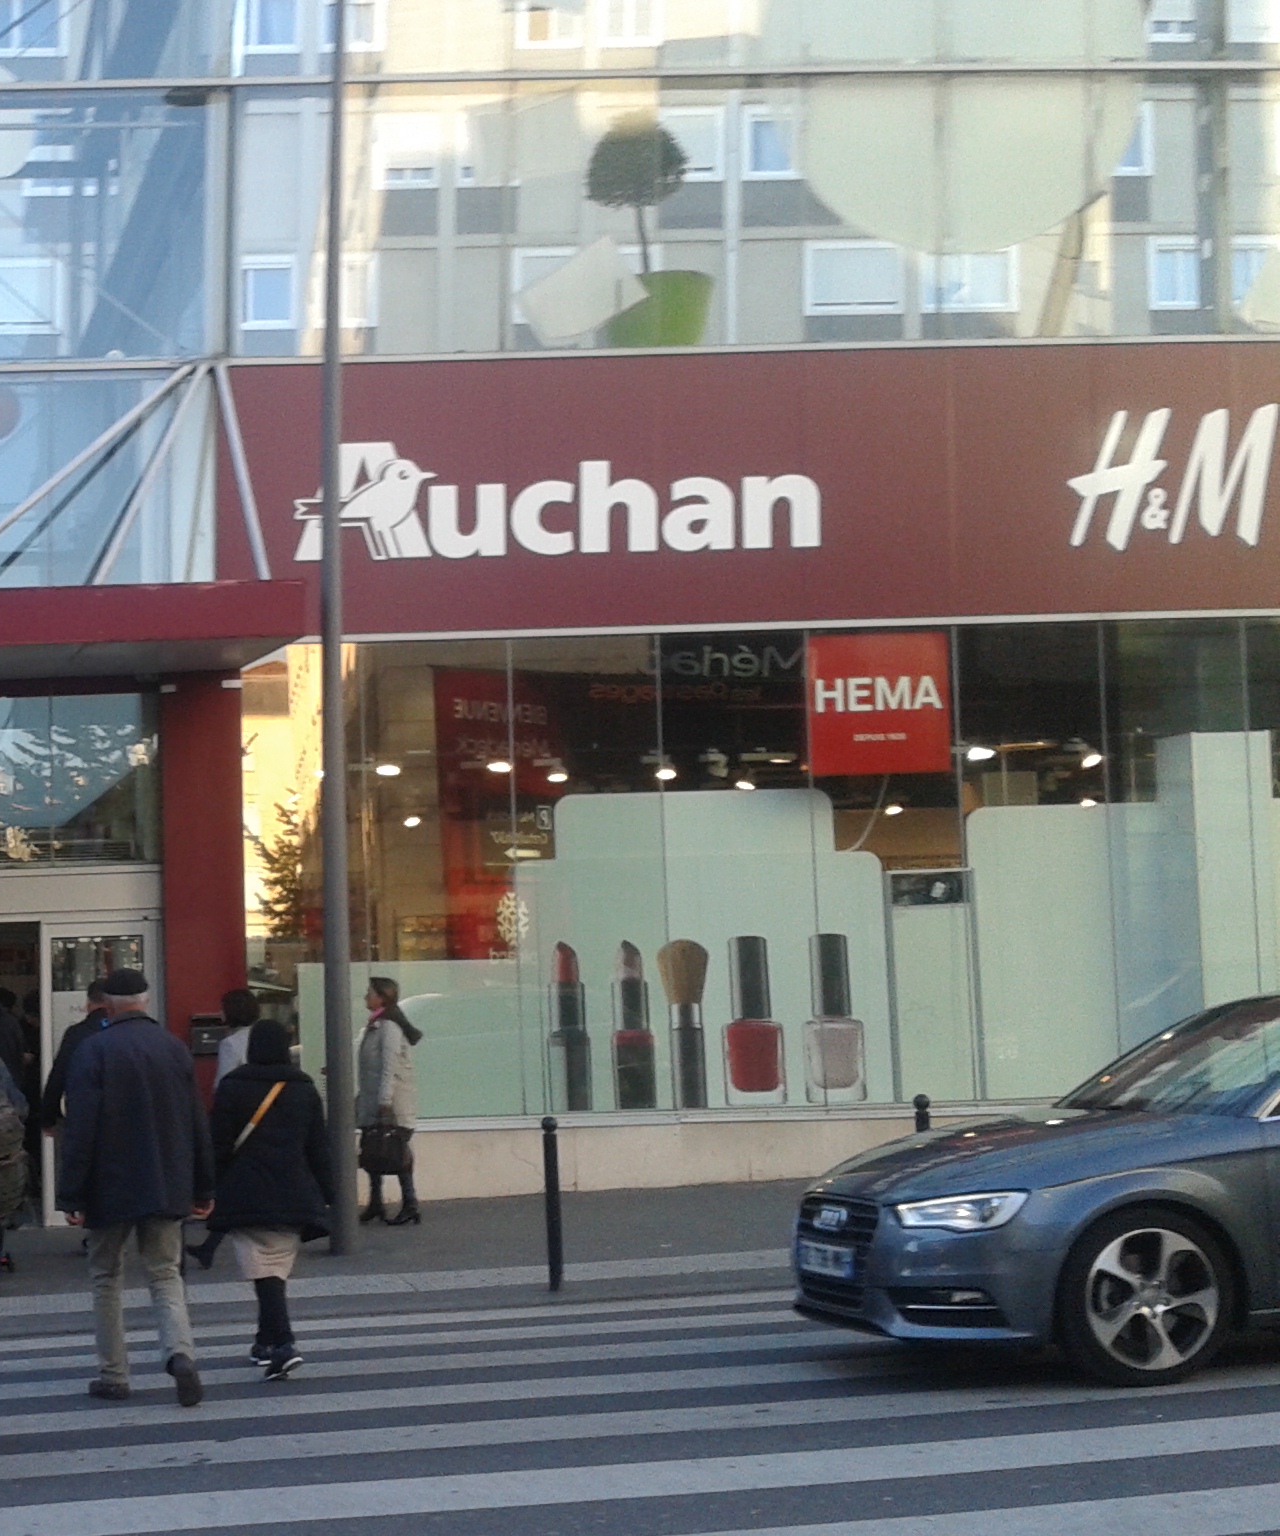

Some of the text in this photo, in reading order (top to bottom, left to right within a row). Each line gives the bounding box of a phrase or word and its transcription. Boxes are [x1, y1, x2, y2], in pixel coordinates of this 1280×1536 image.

[293, 440, 823, 562] Auchan
[1065, 402, 1280, 551] H&M
[814, 675, 944, 713] HEMA
